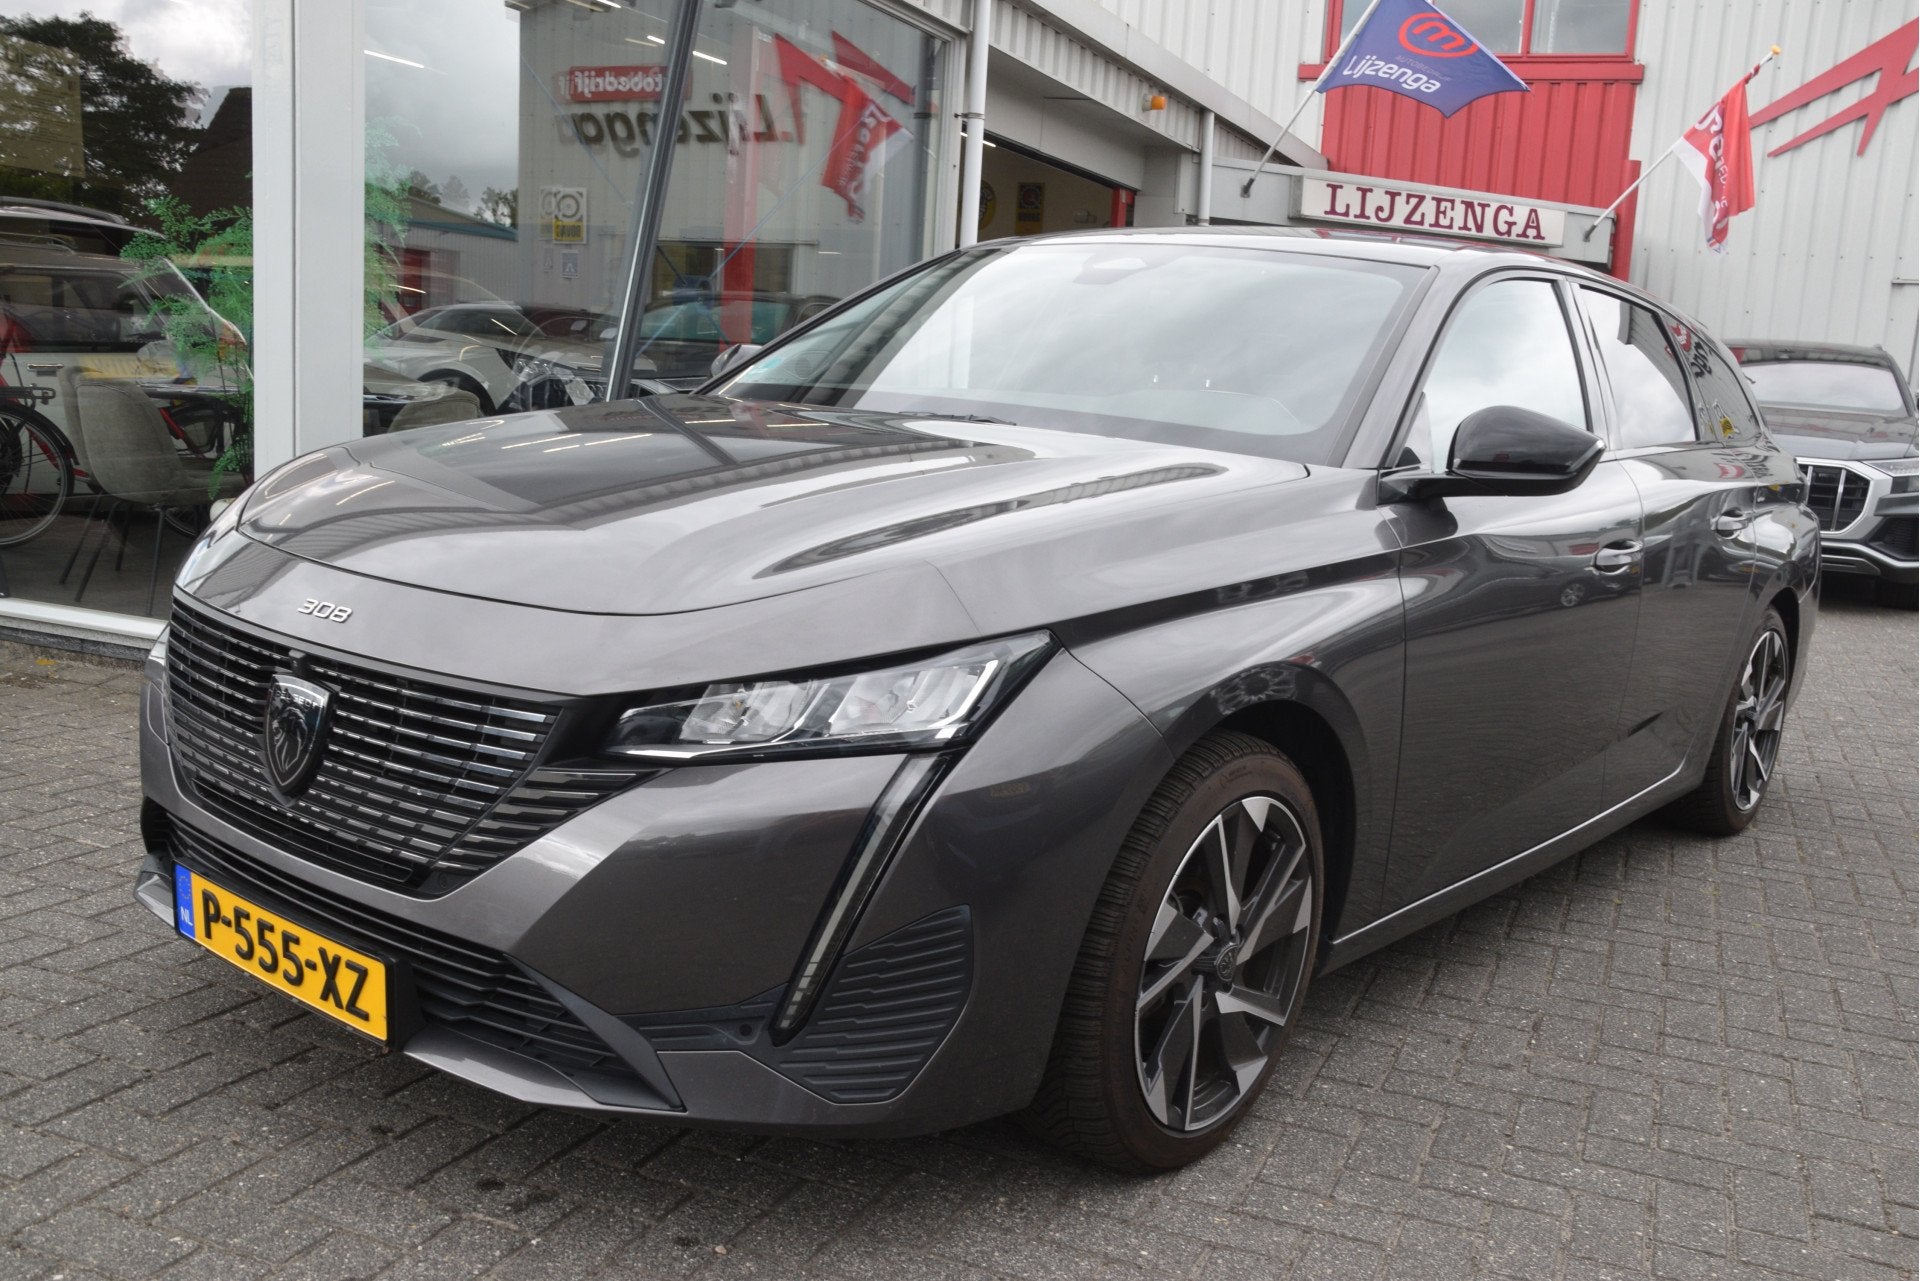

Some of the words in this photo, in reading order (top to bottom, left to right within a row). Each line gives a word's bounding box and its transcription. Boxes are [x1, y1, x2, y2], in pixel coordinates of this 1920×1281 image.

[1342, 55, 1442, 93] Lijzenga
[1324, 183, 1545, 241] LIJZENGA
[297, 598, 354, 623] 308
[180, 906, 193, 926] NL
[201, 888, 370, 1022] P-555-XZ
